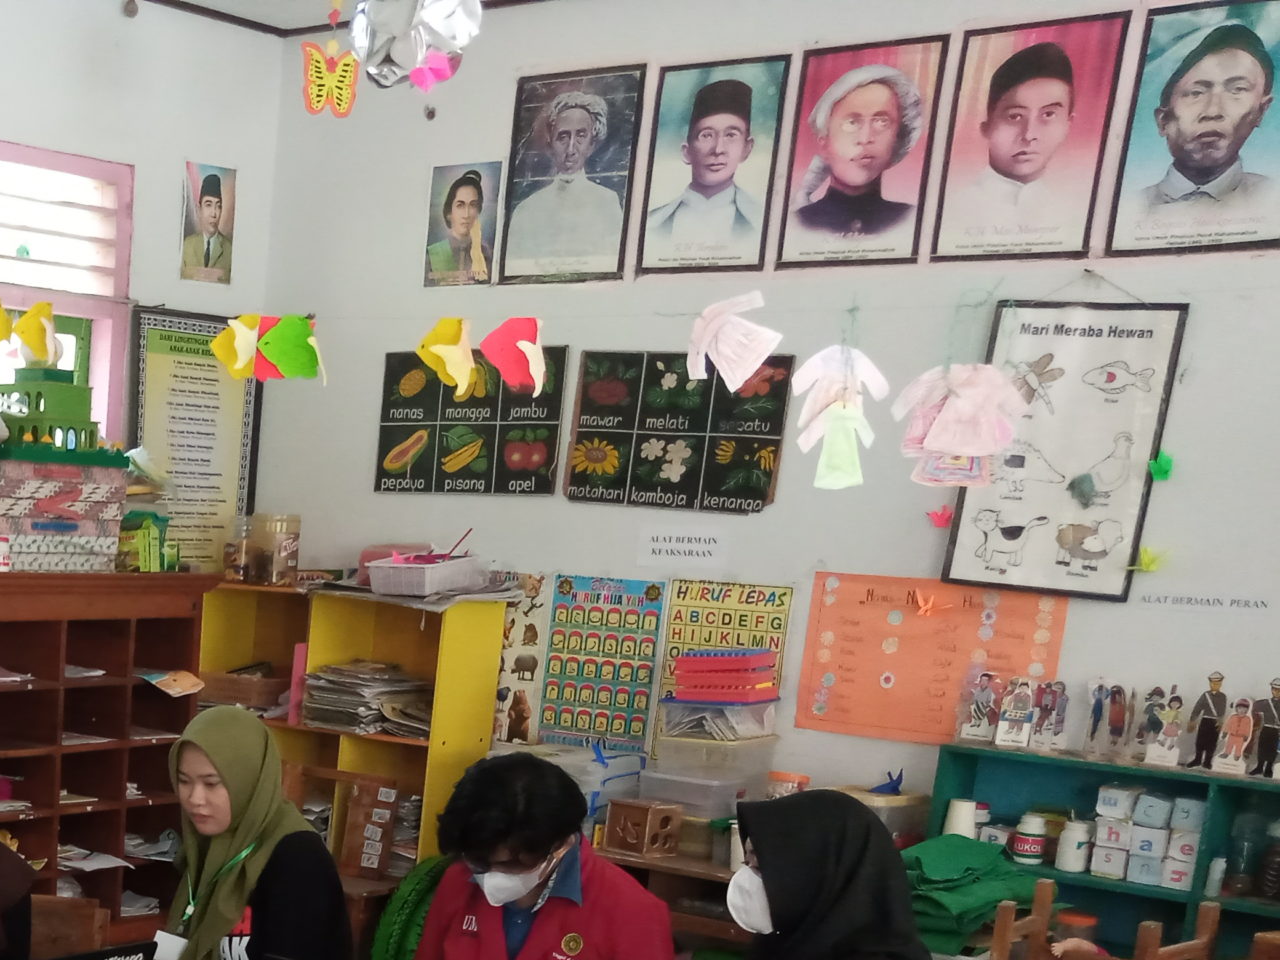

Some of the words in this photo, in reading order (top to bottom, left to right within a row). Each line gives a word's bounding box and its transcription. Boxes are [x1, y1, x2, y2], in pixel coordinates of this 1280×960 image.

[1019, 323, 1050, 336] Mari
[1053, 323, 1104, 338] Meraba
[1107, 325, 1154, 339] Hewan
[389, 407, 424, 420] nanas
[445, 407, 490, 422] mangga
[507, 402, 547, 420] jambu
[580, 414, 622, 427] mawar
[645, 413, 689, 430] melati
[381, 477, 425, 493] pepaya
[444, 476, 485, 493] pisang
[508, 476, 535, 493] apel
[567, 484, 623, 502] matahari
[631, 488, 687, 508] kamboja
[704, 492, 762, 512] kenanga
[649, 535, 673, 544] ALAT
[571, 591, 602, 604] HURUF
[676, 584, 733, 604] HURUF
[737, 589, 787, 608] LEPAS
[1141, 595, 1169, 604] ALAT
[1171, 596, 1224, 607] BERMAIN
[1229, 598, 1269, 608] PERAN
[673, 609, 684, 623] A
[690, 610, 700, 624] B
[705, 611, 716, 625] C
[721, 612, 733, 626] D
[738, 614, 748, 628] E
[755, 615, 765, 628] F
[771, 616, 782, 631] G
[672, 627, 682, 641] H
[704, 630, 712, 643] J
[720, 631, 731, 645] K
[736, 633, 745, 646] L
[751, 634, 764, 648] M
[769, 636, 780, 650] N
[669, 646, 680, 659] O
[665, 689, 673, 699] a
[1106, 826, 1120, 842] h
[1139, 839, 1153, 852] a
[1179, 843, 1195, 856] e
